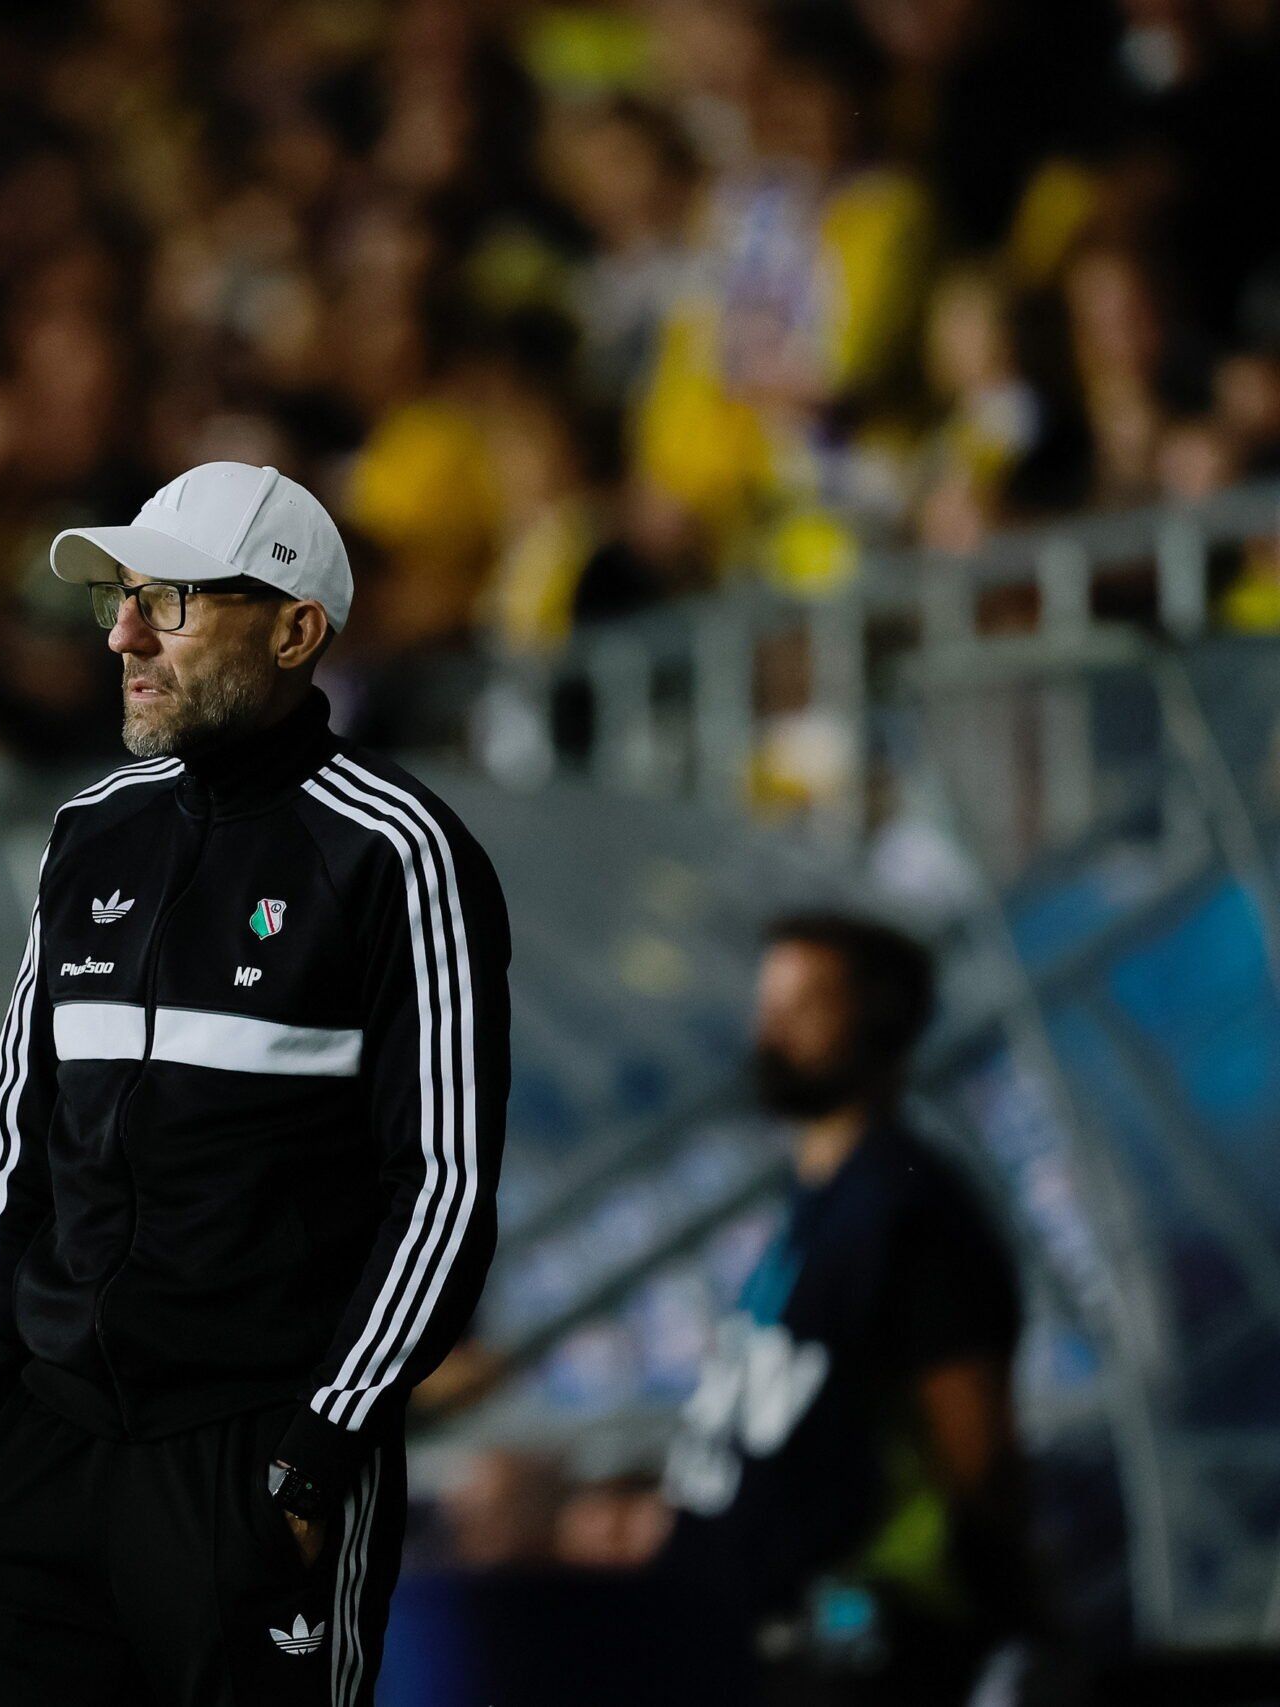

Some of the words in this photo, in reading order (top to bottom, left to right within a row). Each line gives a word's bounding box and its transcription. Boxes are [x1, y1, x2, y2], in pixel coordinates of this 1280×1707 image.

[271, 542, 297, 565] MP
[60, 959, 114, 976] Plus500
[234, 966, 262, 986] MP
